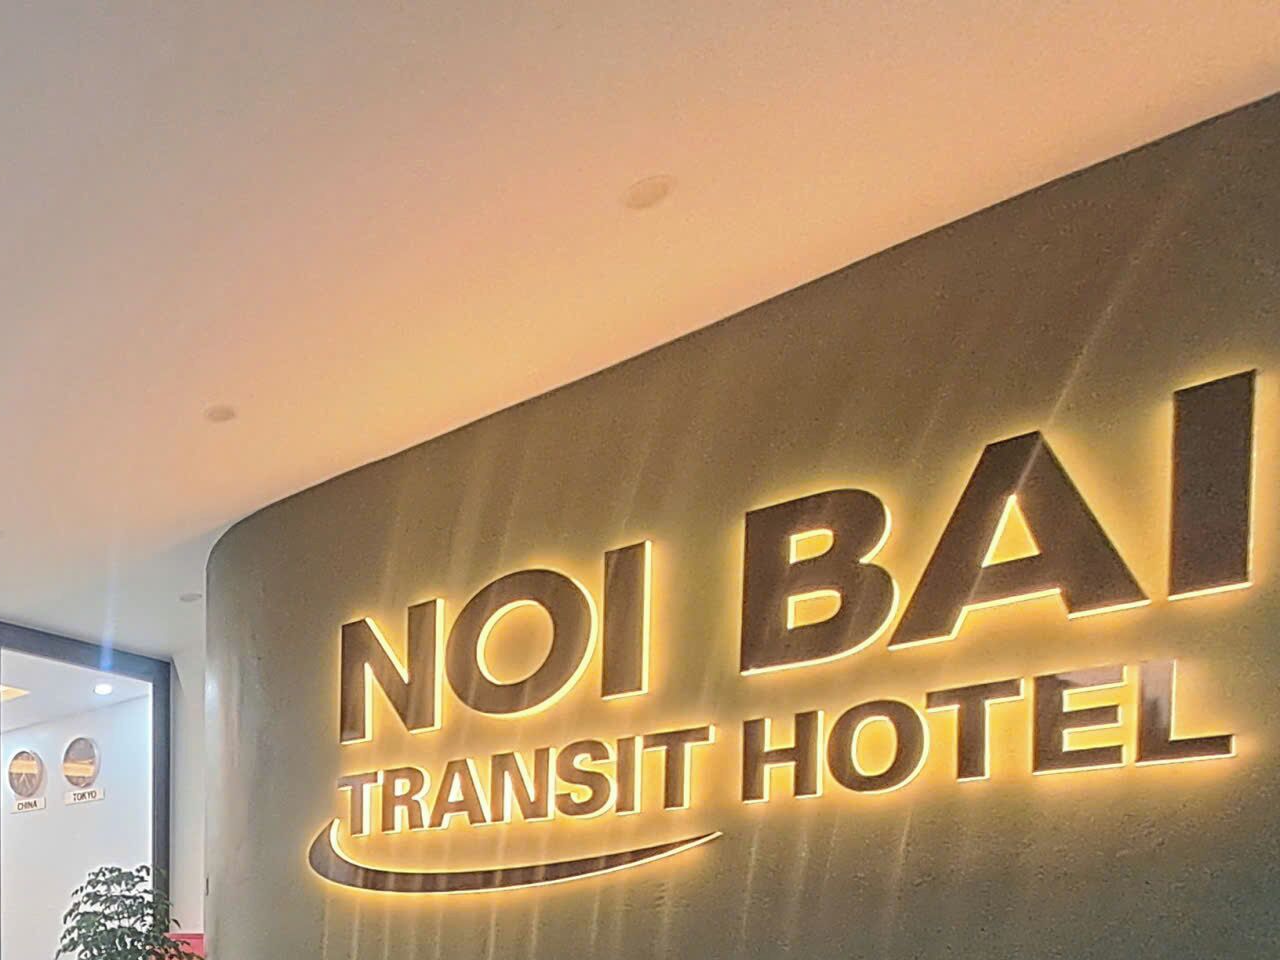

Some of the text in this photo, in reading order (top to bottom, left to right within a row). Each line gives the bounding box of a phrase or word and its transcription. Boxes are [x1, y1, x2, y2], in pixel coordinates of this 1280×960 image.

[341, 369, 1257, 743] NOI BAI
[338, 659, 1235, 837] TRANSIT HOTEL
[17, 800, 37, 811] CHINA
[73, 790, 97, 802] TOKYO
